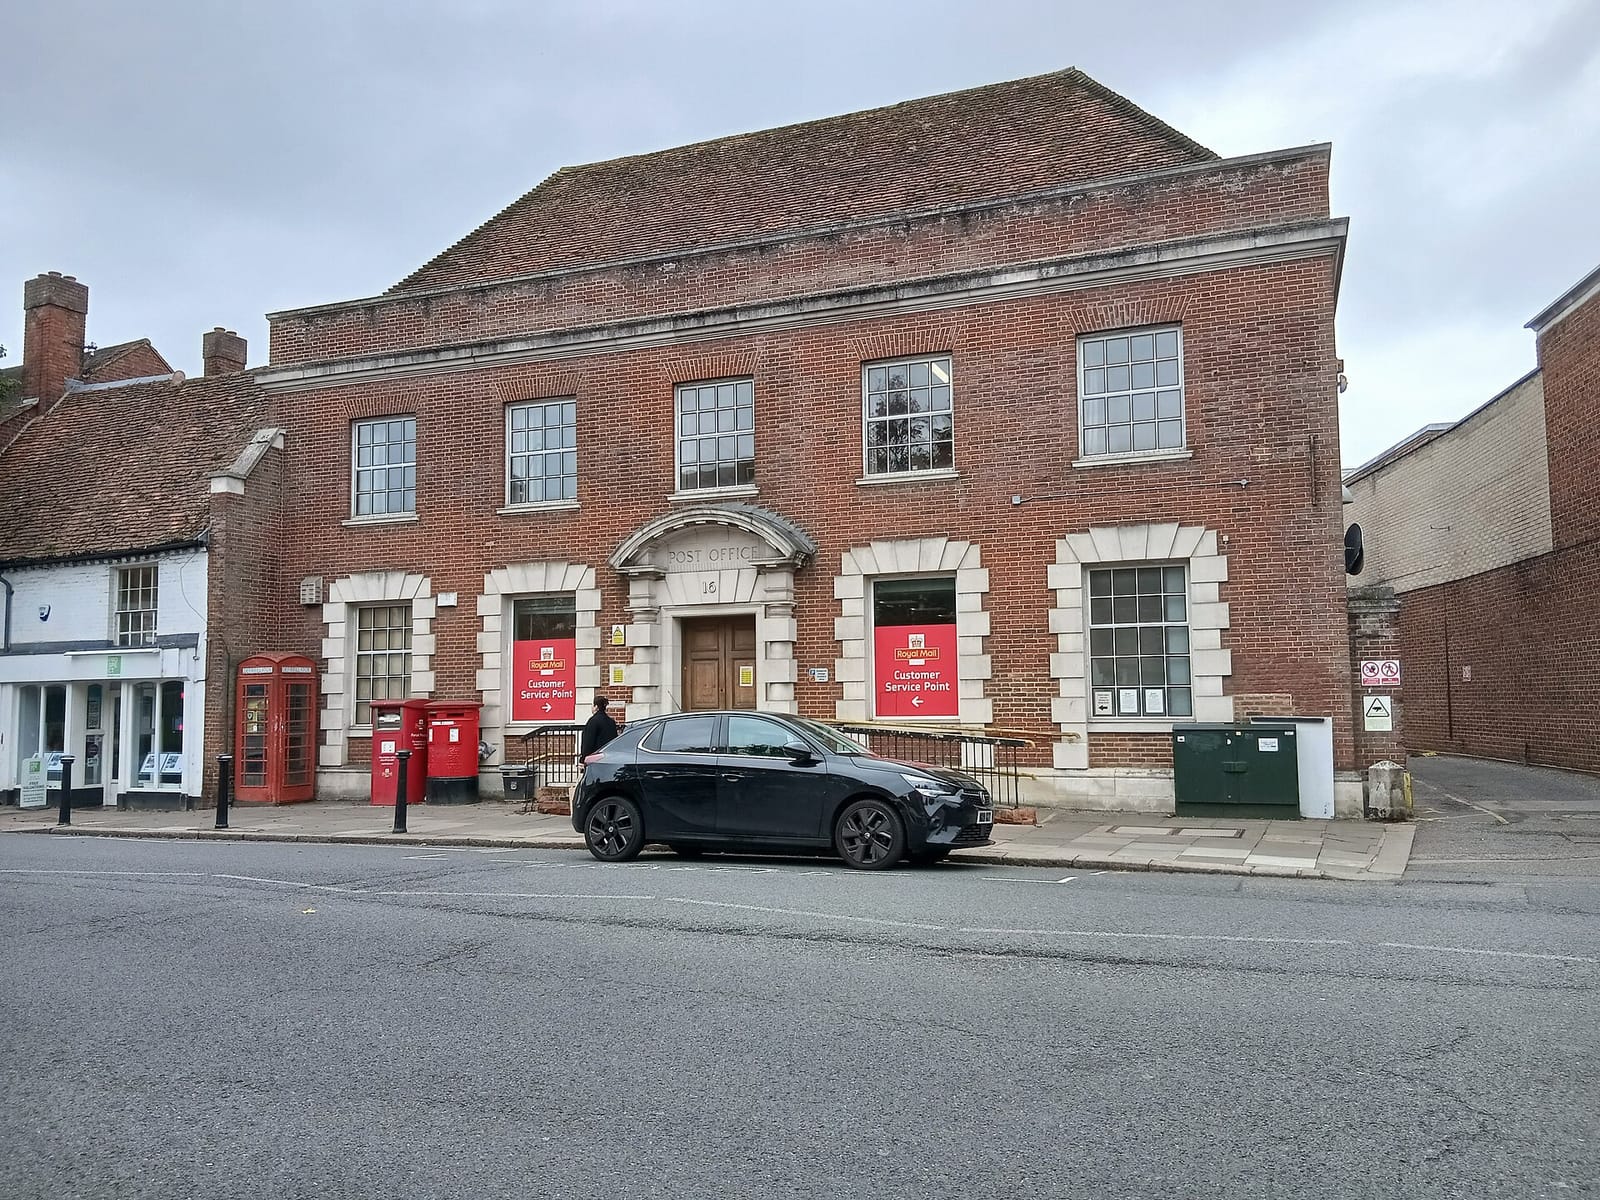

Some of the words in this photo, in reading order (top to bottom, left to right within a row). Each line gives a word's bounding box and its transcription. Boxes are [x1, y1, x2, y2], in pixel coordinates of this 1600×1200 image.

[669, 550, 702, 563] POST
[709, 546, 758, 561] OFFICE
[702, 581, 717, 594] 16
[897, 650, 918, 658] Royal
[919, 649, 937, 657] Mail
[531, 661, 548, 669] Royal
[549, 661, 563, 669] Mail
[894, 671, 940, 680] Customer
[528, 680, 565, 688] Customer
[885, 682, 921, 691] Service
[924, 682, 950, 691] Point
[521, 690, 550, 699] Service
[552, 690, 573, 698] Point
